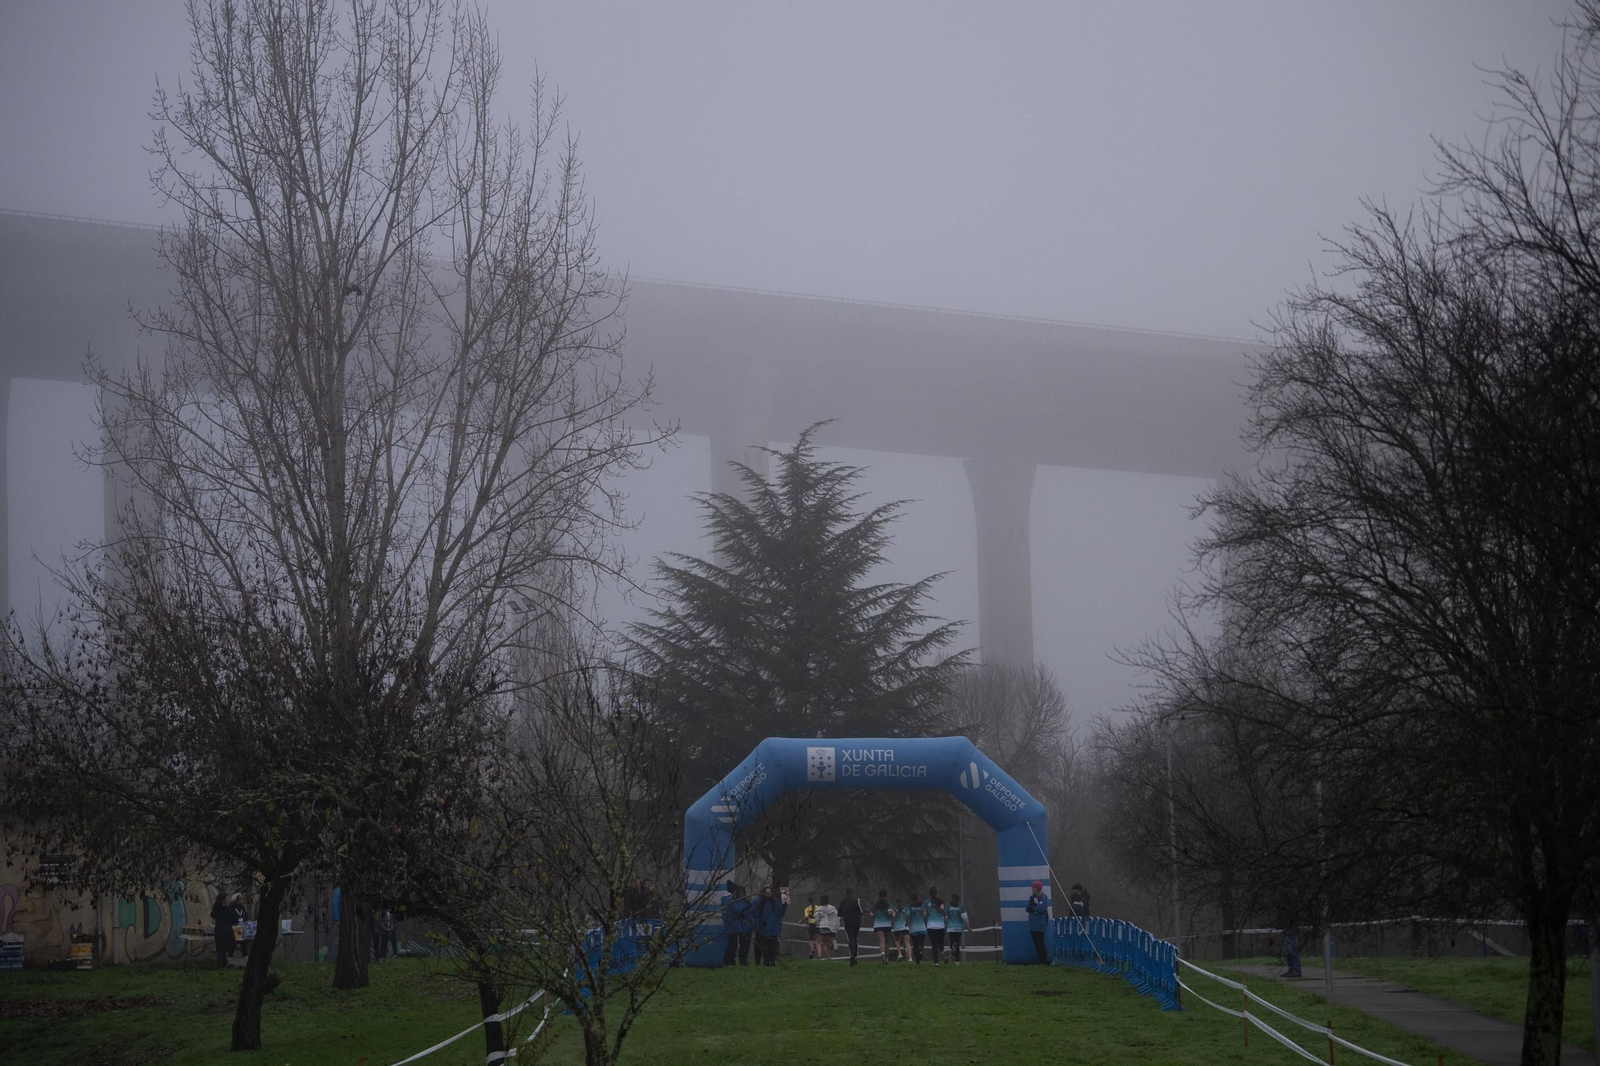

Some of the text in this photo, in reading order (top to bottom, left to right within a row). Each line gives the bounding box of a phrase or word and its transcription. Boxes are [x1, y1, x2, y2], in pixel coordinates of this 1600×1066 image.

[842, 749, 894, 762] XUNTA
[729, 762, 766, 796] DEPORTE
[842, 764, 927, 778] DE GALICIA
[984, 784, 1017, 812] GALEGO
[989, 777, 1027, 809] DEPORTE
